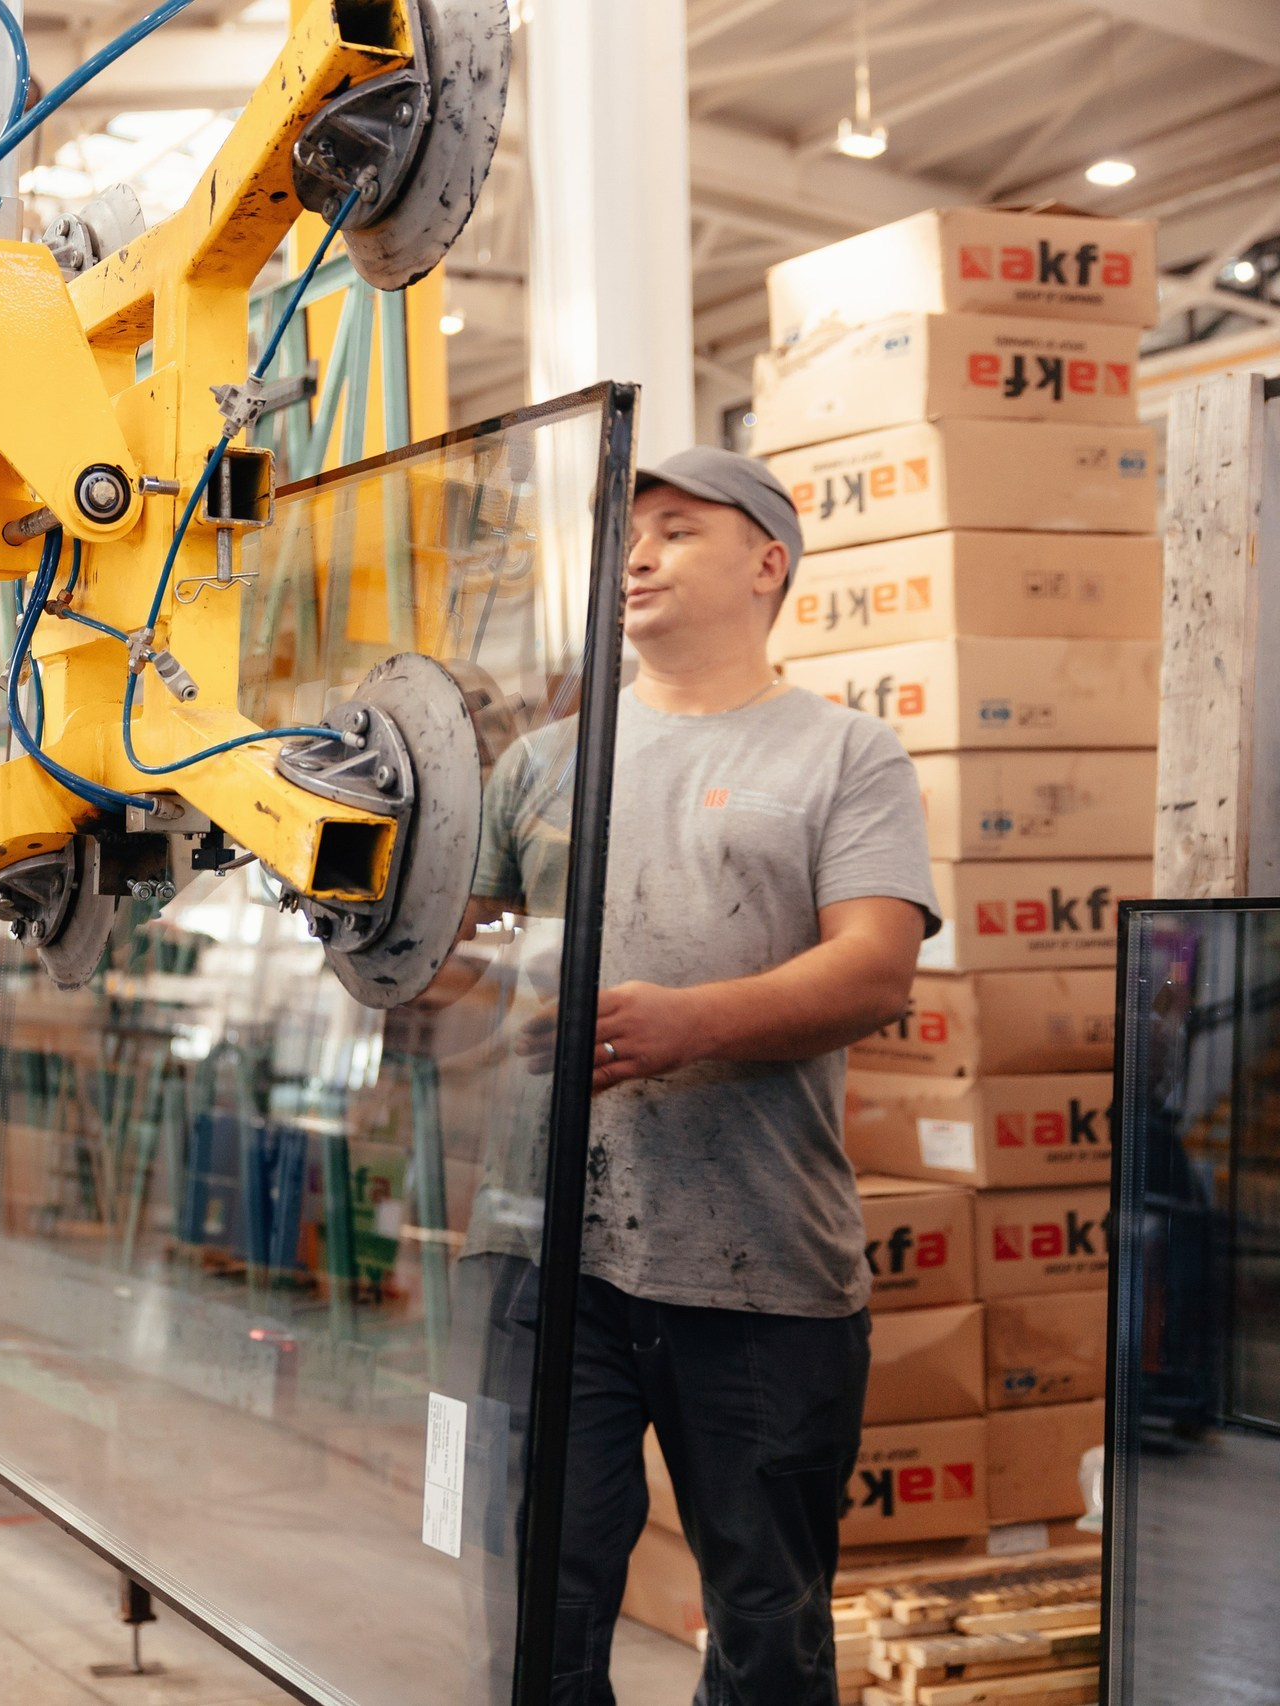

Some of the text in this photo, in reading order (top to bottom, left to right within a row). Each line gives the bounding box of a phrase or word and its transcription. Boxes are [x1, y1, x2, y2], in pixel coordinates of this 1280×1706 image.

[1000, 239, 1132, 287] akfa
[968, 354, 1097, 401] akfa
[792, 464, 896, 520] akfa
[797, 582, 899, 631] akfa
[823, 675, 924, 718] kfa
[1014, 886, 1132, 933] akf
